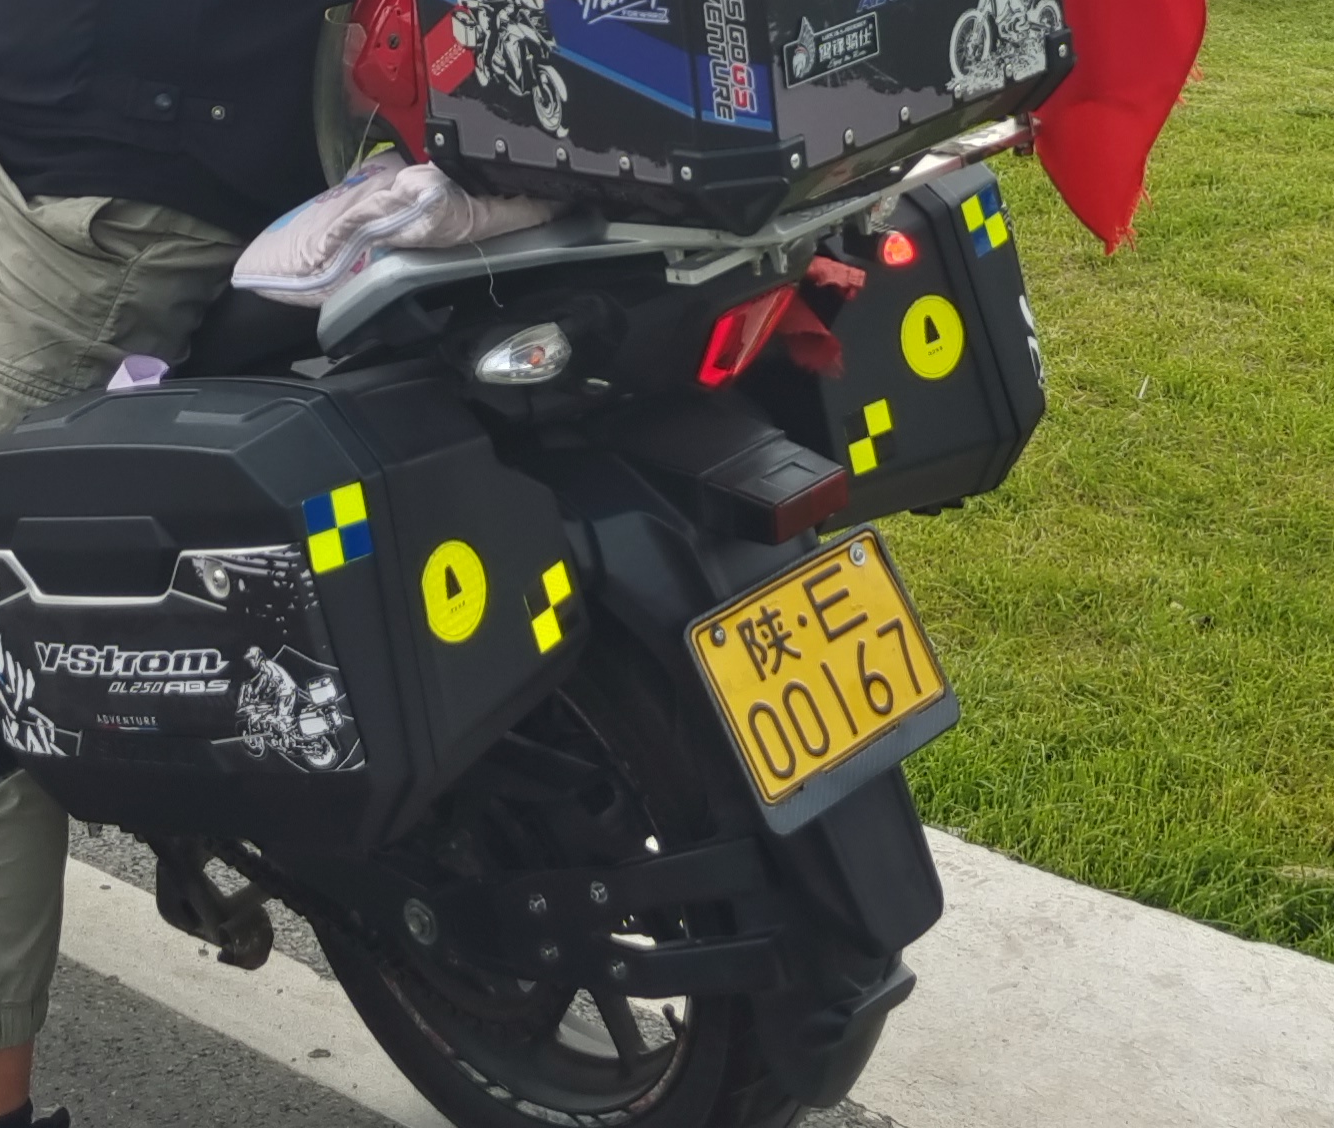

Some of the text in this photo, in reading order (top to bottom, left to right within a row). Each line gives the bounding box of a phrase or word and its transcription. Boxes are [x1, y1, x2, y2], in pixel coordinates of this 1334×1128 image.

[34, 641, 230, 676] V-Strom
[747, 618, 923, 779] 00167
[96, 713, 157, 726] ADVENTURE
